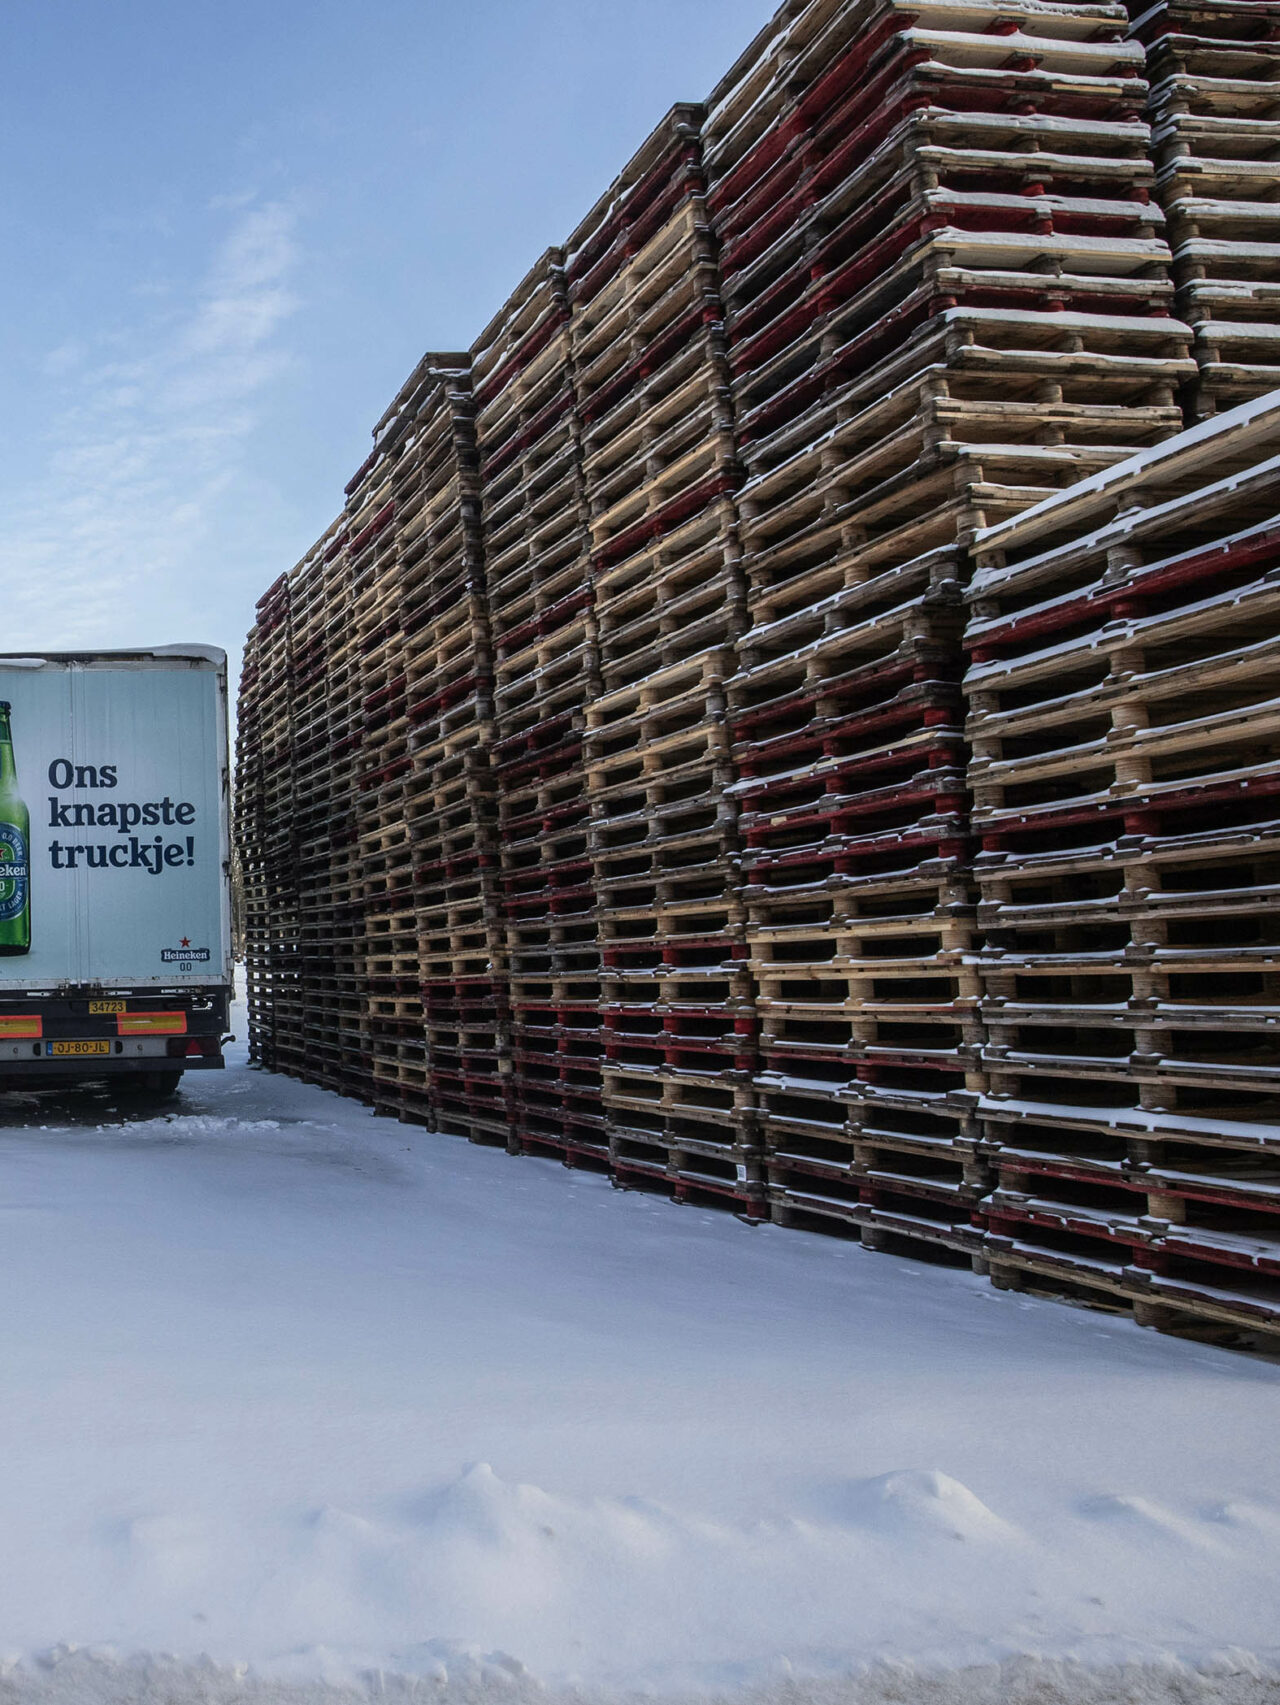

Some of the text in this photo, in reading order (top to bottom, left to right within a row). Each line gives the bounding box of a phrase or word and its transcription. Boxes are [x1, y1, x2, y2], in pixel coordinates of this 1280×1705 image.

[48, 758, 118, 789] Ons
[48, 797, 196, 833] knapste
[48, 835, 194, 875] truckje!
[163, 951, 208, 960] Heineken
[91, 1002, 124, 1012] 34723
